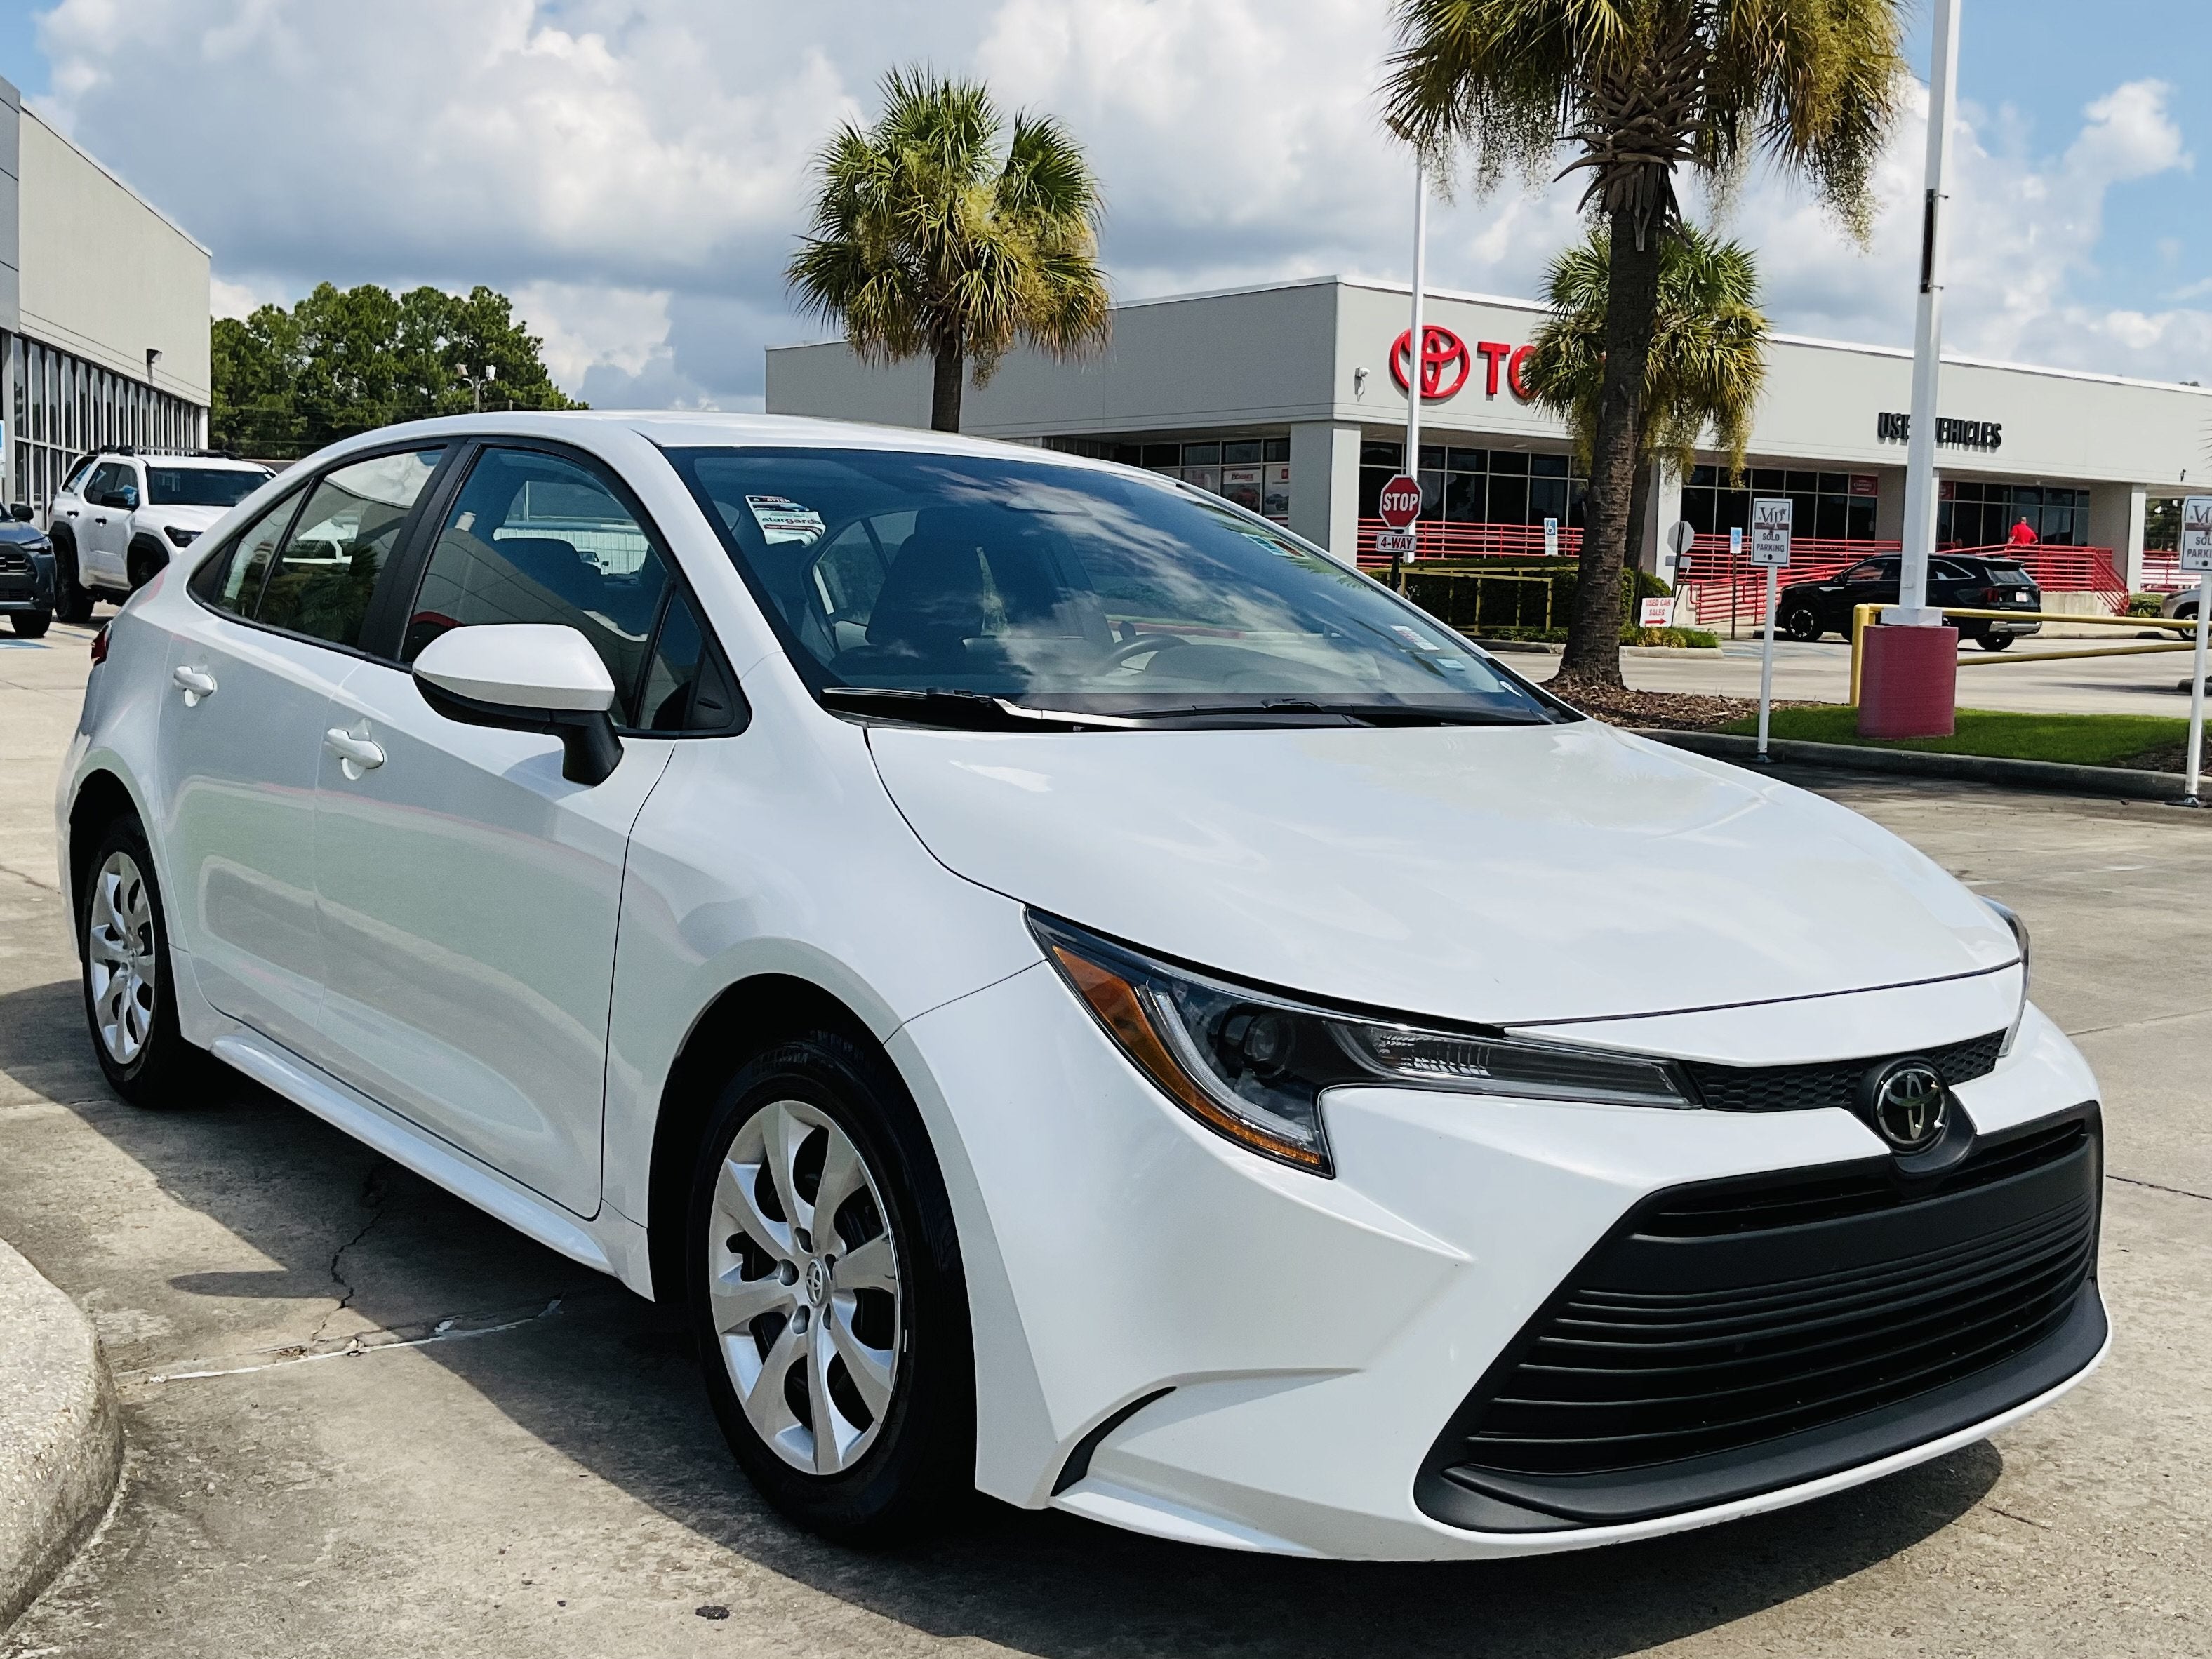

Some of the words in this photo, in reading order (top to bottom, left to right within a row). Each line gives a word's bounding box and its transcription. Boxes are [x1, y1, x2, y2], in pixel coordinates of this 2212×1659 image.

[1877, 412, 1910, 439] USE
[1382, 493, 1418, 511] STOP
[1762, 533, 1780, 541] SOLD
[2195, 536, 2212, 545] SOL
[1380, 536, 1413, 549] 4-WAY
[1756, 543, 1785, 552] PARKING
[2187, 549, 2212, 558] PARKI
